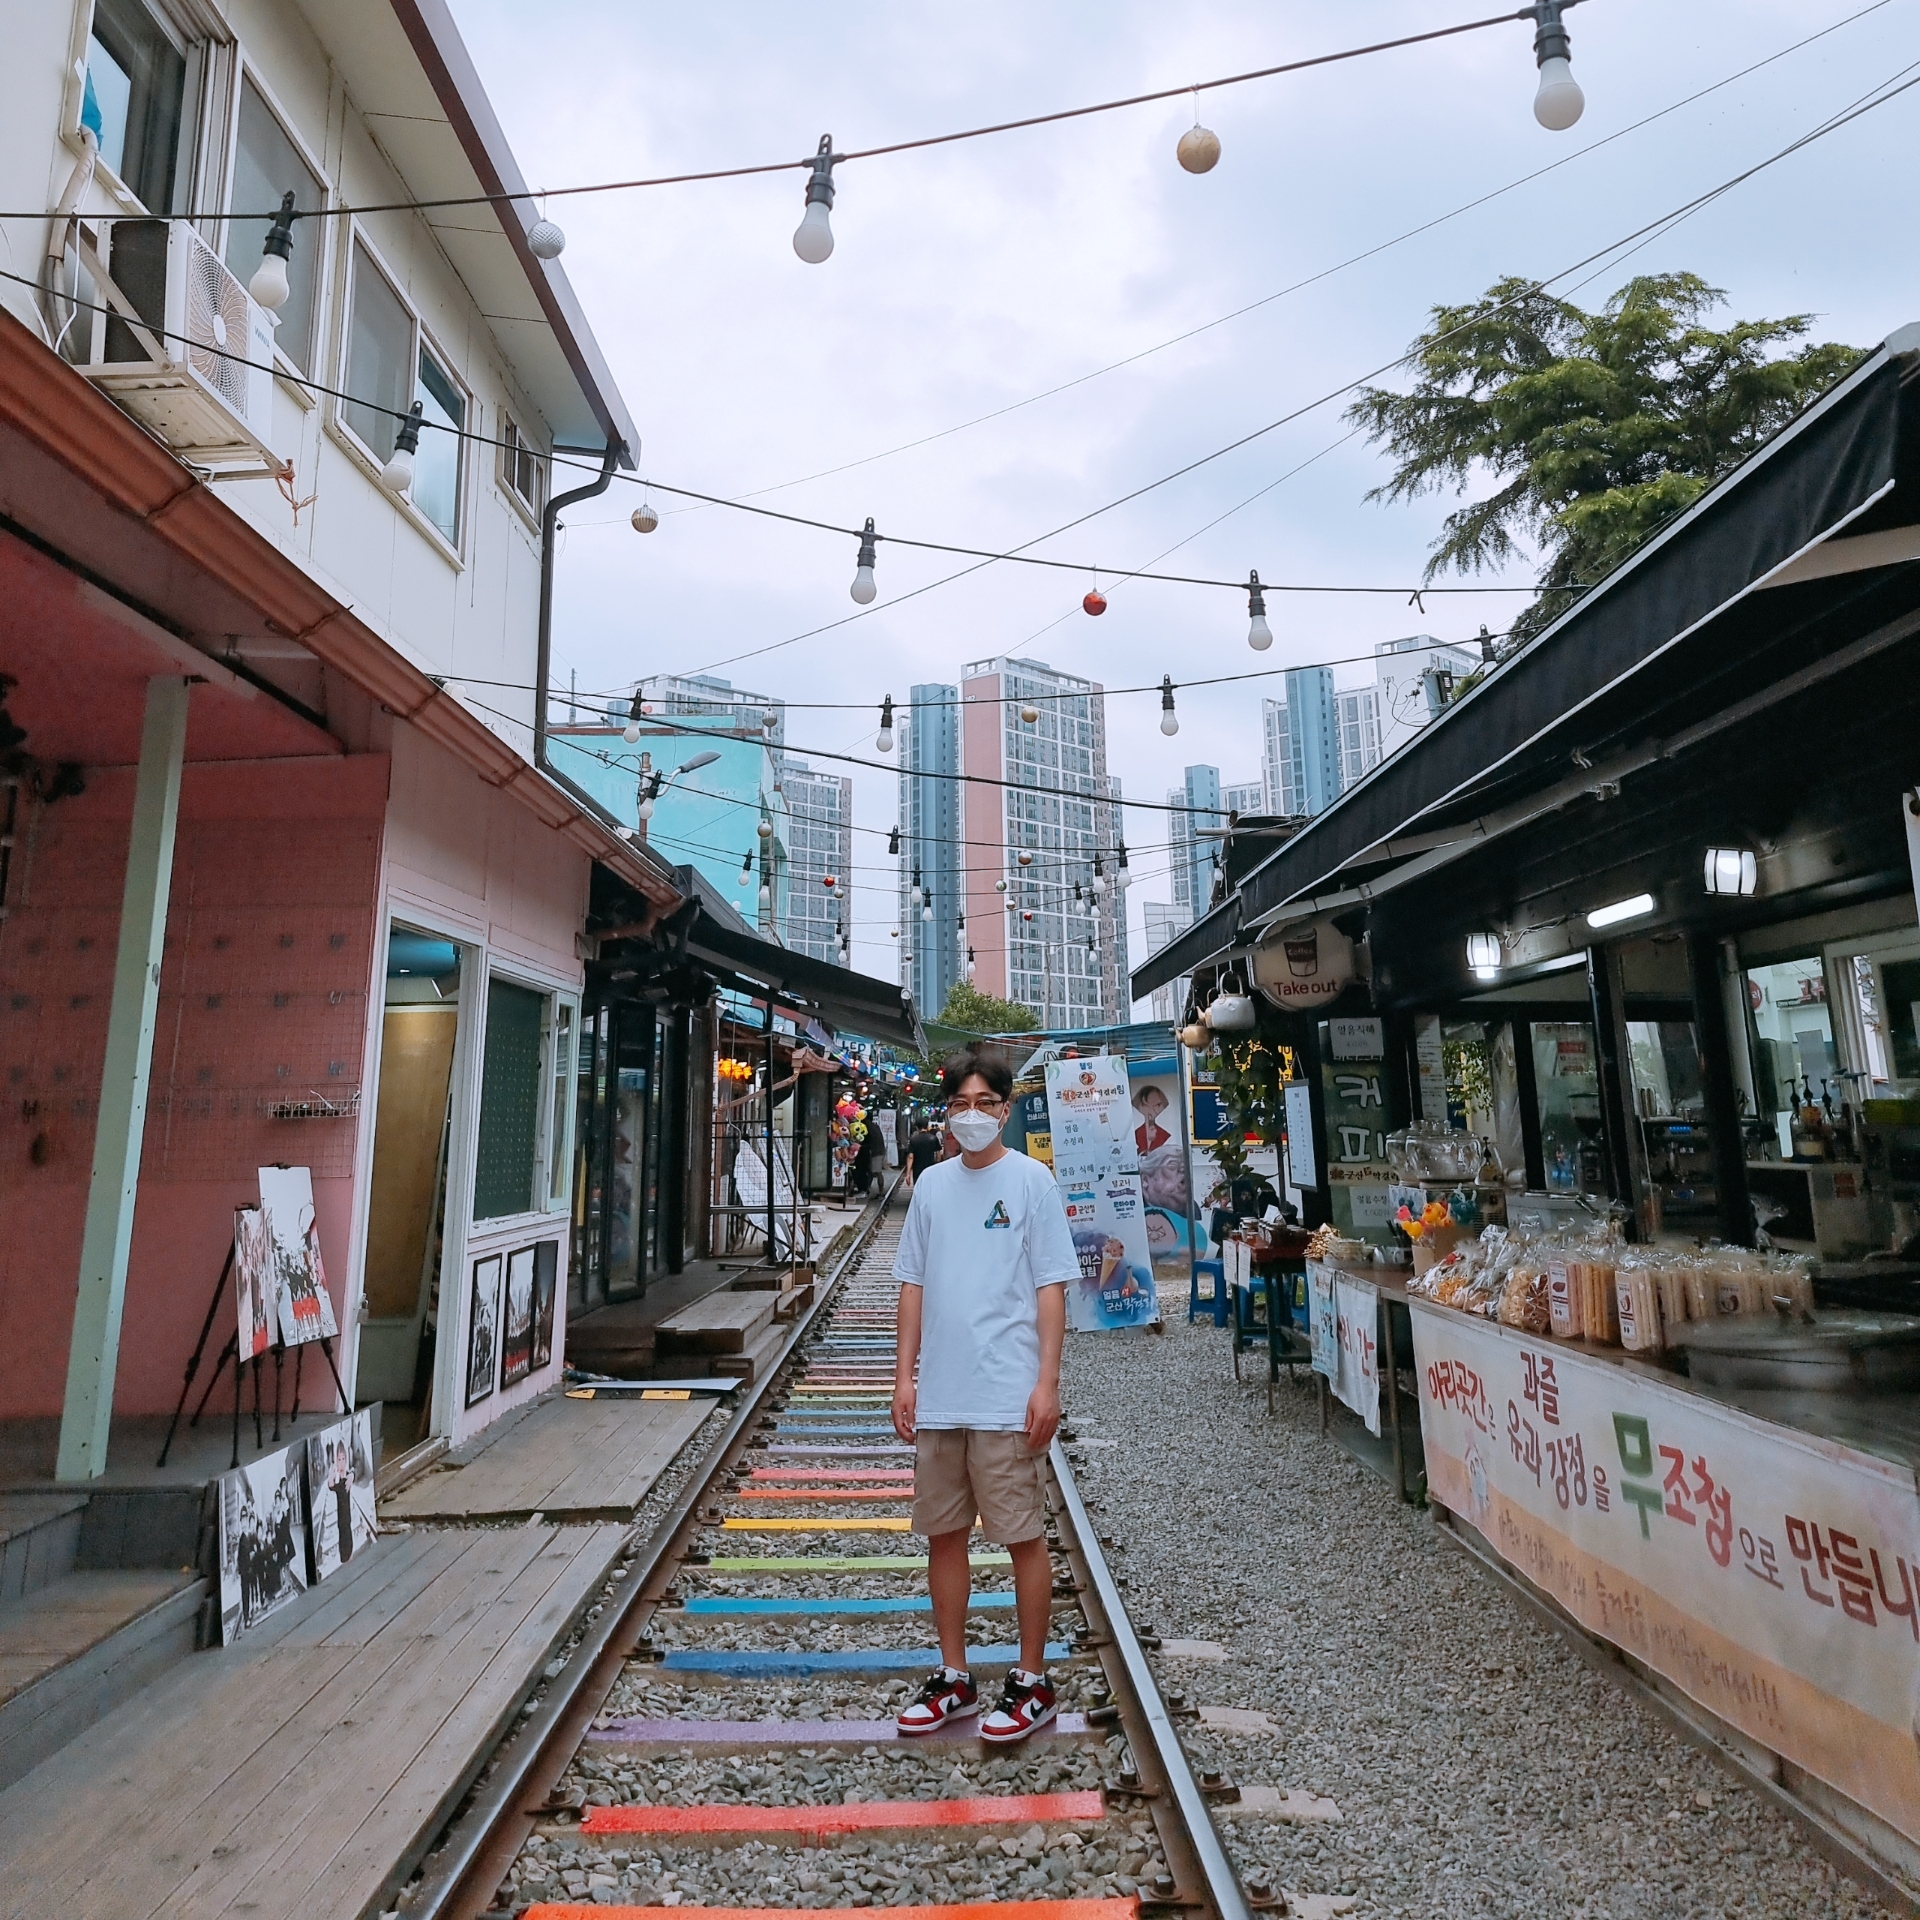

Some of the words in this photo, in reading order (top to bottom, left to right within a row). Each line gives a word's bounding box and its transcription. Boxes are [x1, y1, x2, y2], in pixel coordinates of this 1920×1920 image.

[1287, 944, 1315, 956] Coffee
[1273, 981, 1309, 996] Take
[1310, 979, 1339, 994] out
[841, 1040, 867, 1054] LED
[1102, 1289, 1120, 1300] 얼음
[1106, 1302, 1123, 1313] 군산
[1520, 1351, 1560, 1426] 과즐
[1507, 1399, 1542, 1489] 유과
[1785, 1514, 1920, 1645] 만듭니
